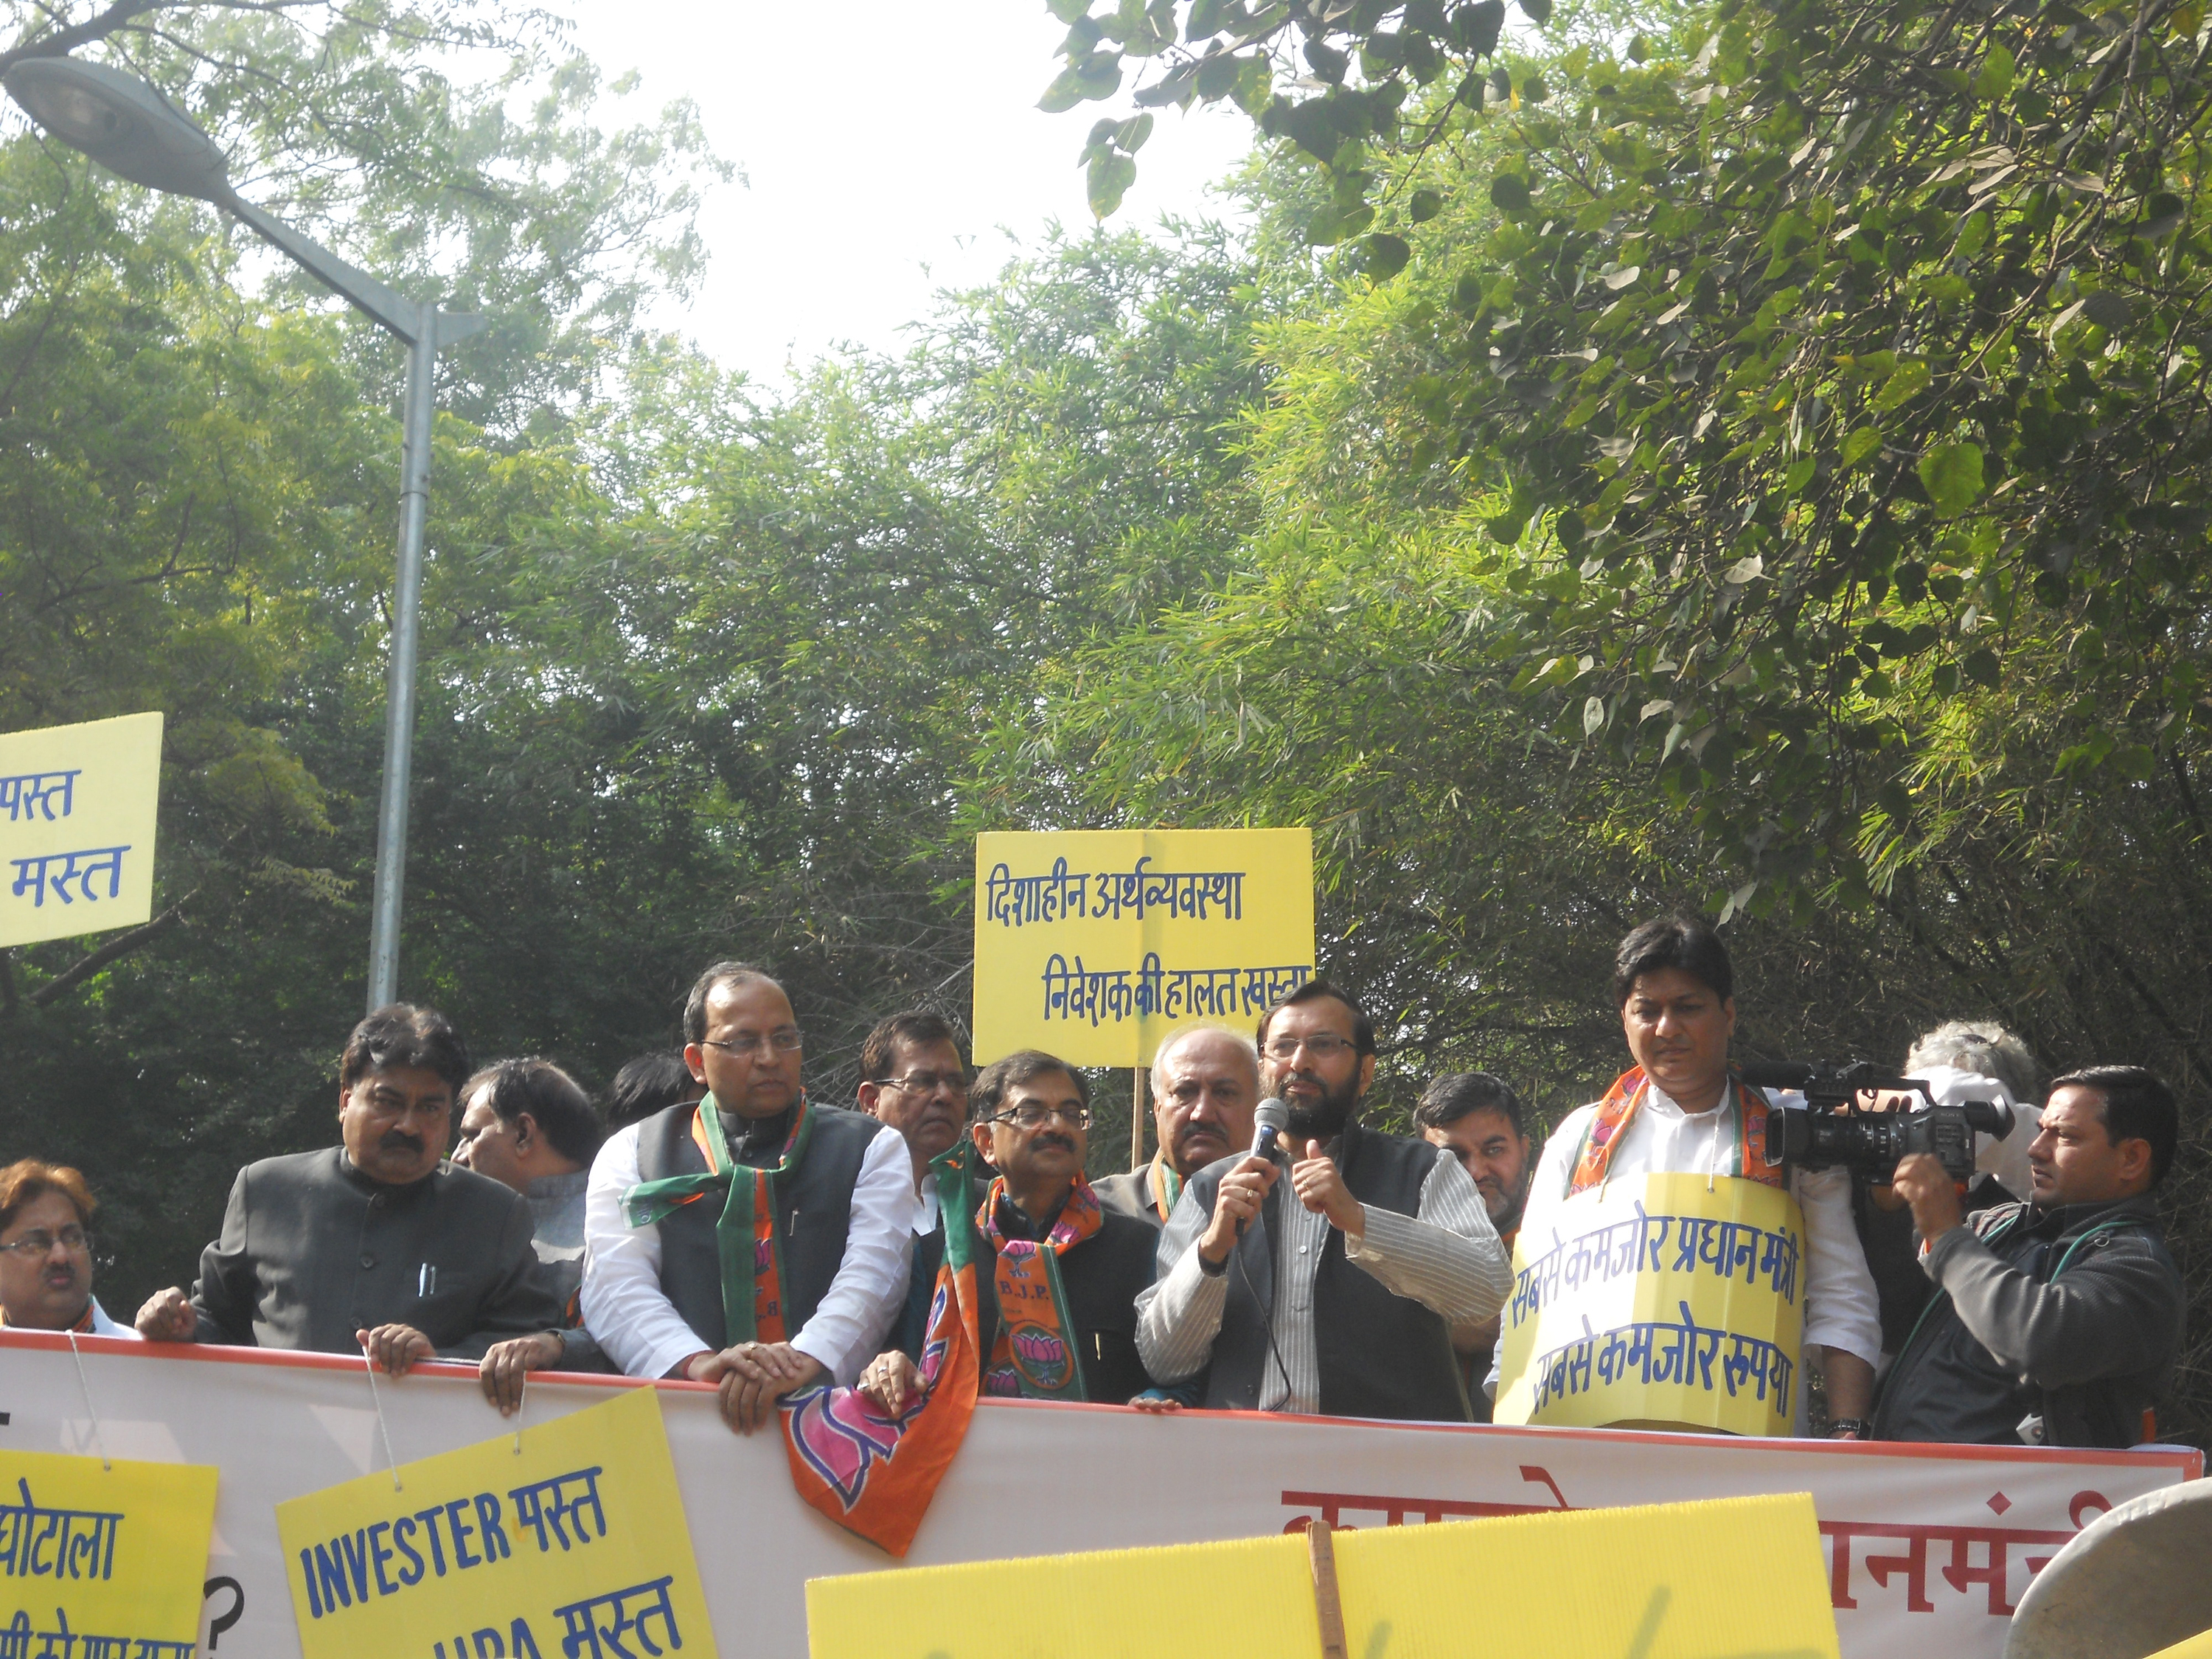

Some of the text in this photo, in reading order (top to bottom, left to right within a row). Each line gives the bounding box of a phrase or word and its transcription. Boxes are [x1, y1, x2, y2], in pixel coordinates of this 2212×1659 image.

[10, 844, 132, 908] मस्त
[986, 856, 1246, 928] दिशाहीन अर्थव्यवस्था
[1041, 953, 1132, 1027] निवेशक
[1133, 952, 1166, 1017] की
[1166, 967, 1241, 1019] हालत
[998, 1280, 1049, 1300] B.J.P.
[1511, 1226, 1567, 1329] सबसे
[1564, 1199, 1676, 1293] कमजोर
[1533, 1313, 1601, 1415] सबसे
[1597, 1300, 1728, 1391] कमजोर
[299, 1465, 608, 1619] INVESTER पस्त
[553, 1574, 684, 1659] मस्त
